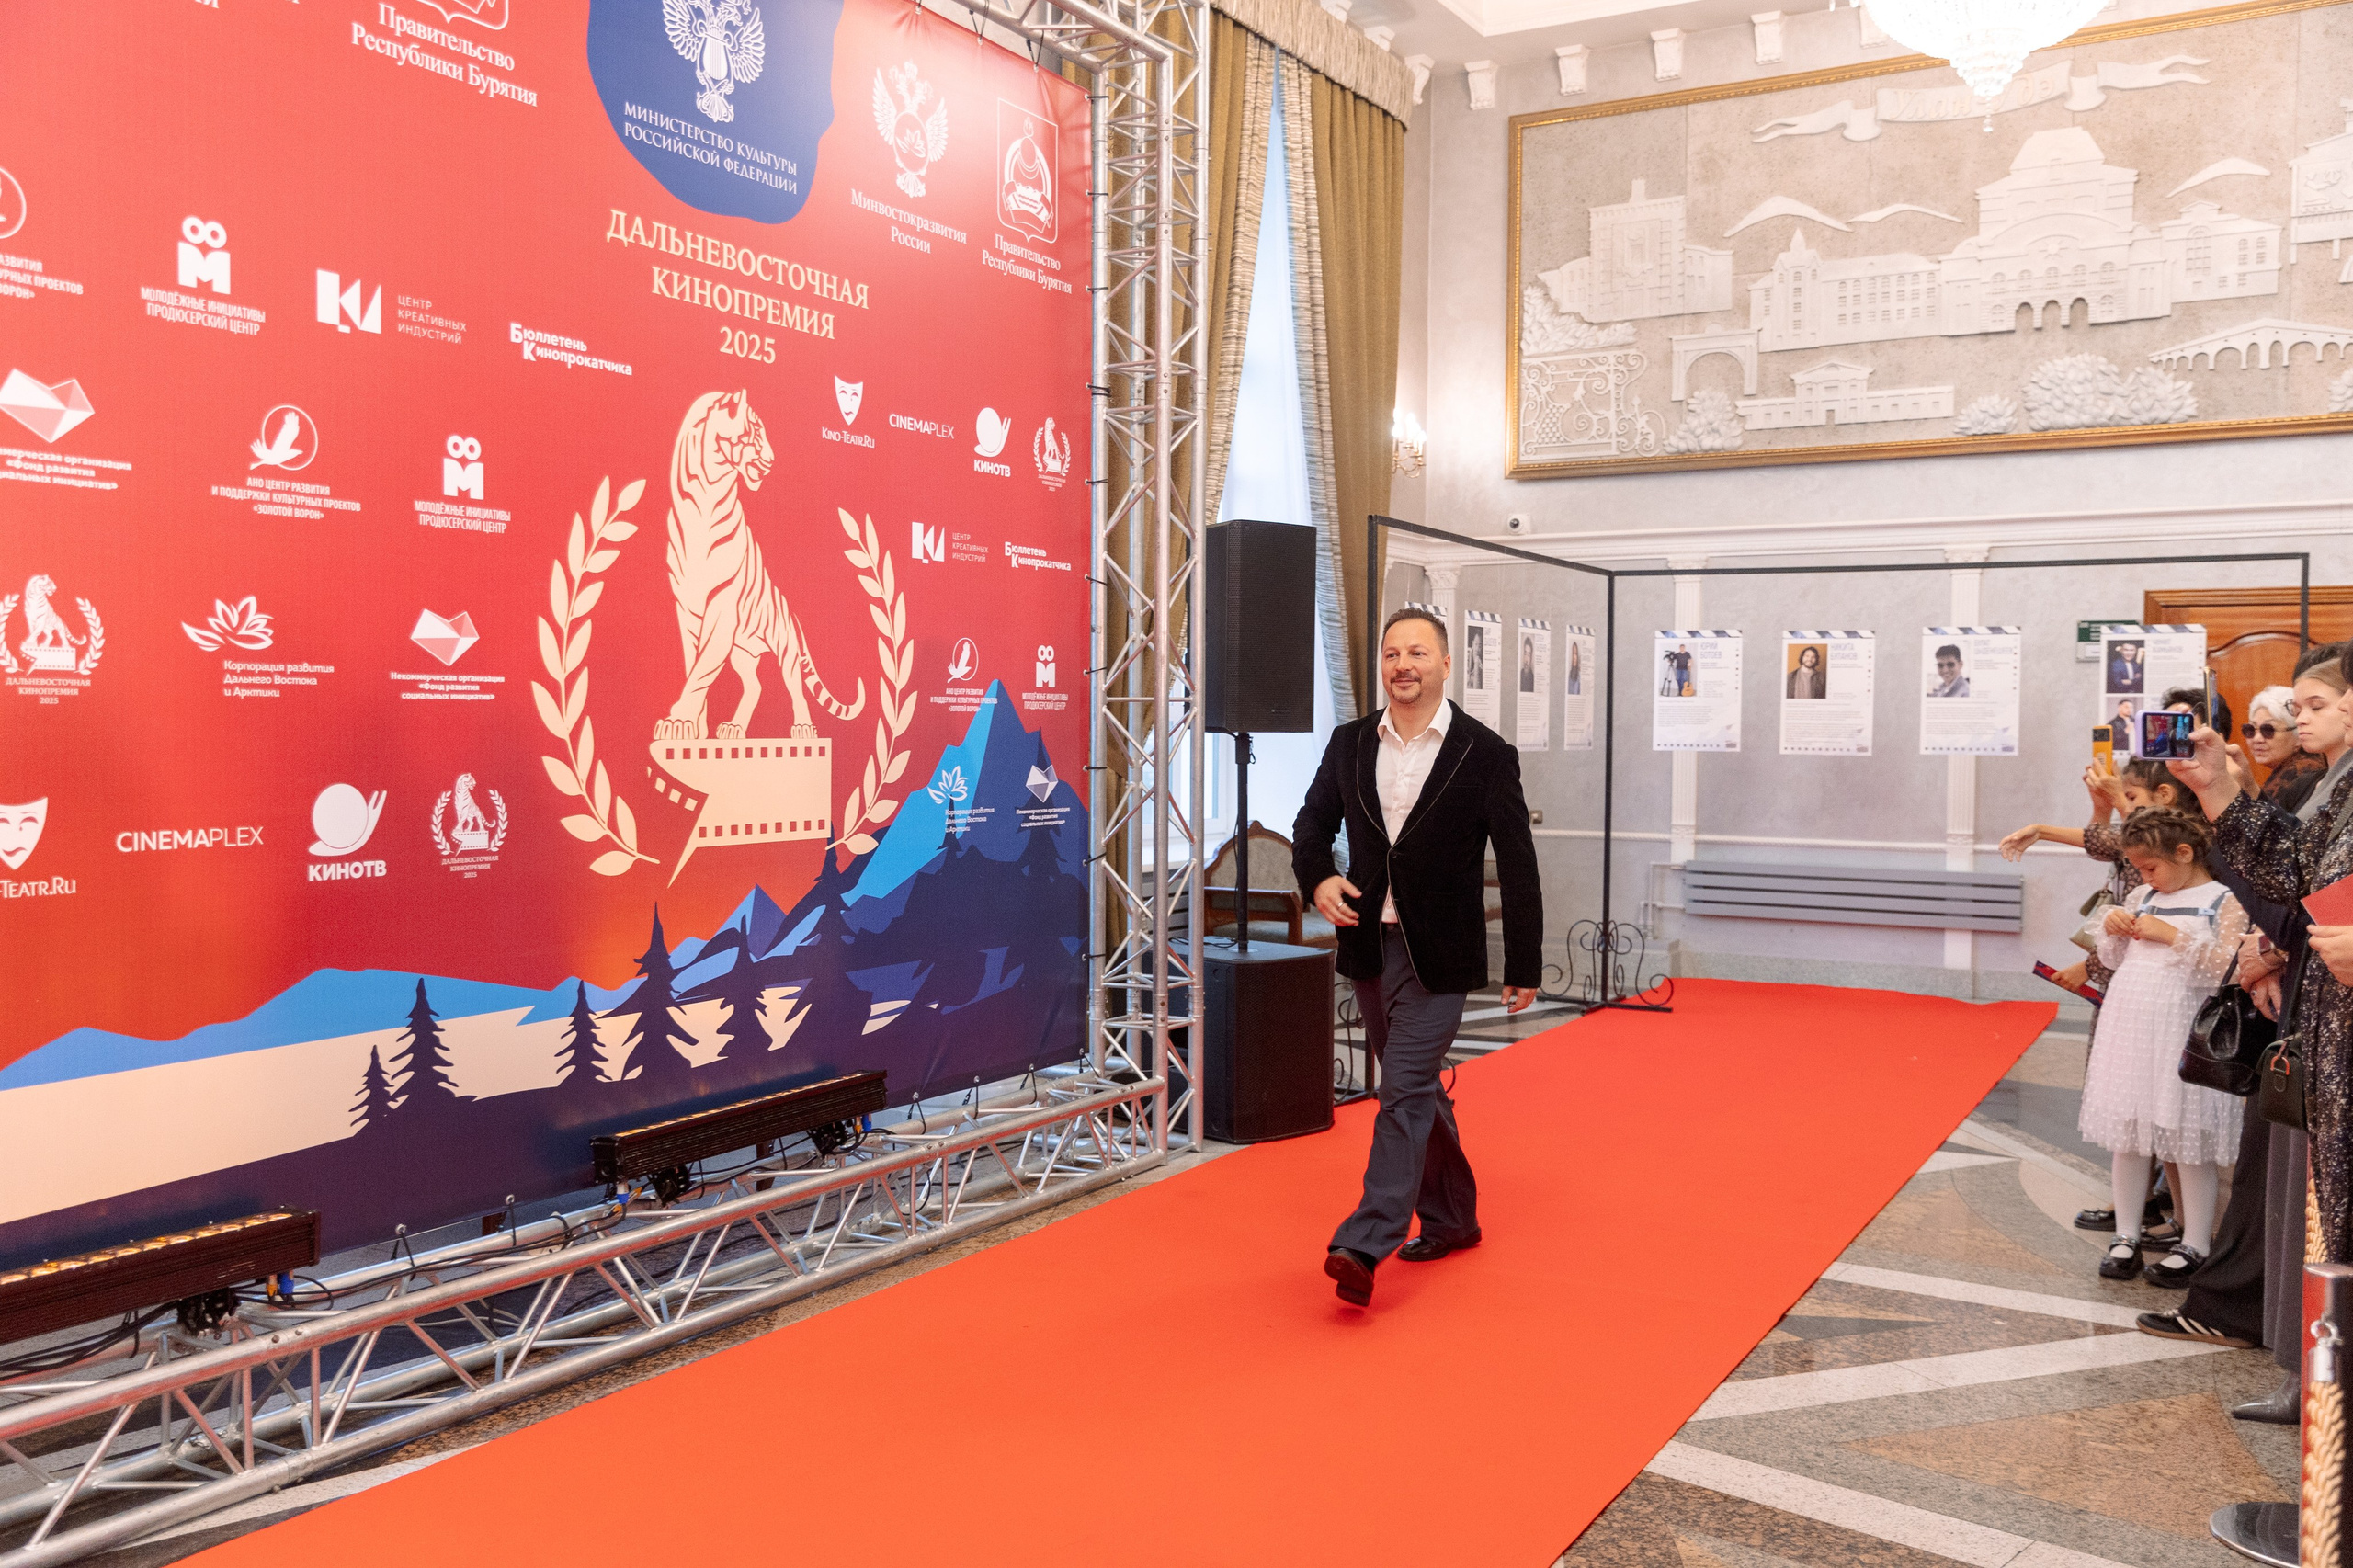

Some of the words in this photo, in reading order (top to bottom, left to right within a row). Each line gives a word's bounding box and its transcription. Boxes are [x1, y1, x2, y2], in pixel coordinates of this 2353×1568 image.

[378, 3, 515, 72] Правительство
[350, 22, 464, 83] Республики
[468, 68, 539, 107] Бурятия
[624, 102, 733, 152] МИНИСТЕРСТВО
[737, 142, 797, 176] КУЛЬТУРЫ
[624, 122, 720, 167] РОССИЙСКОЙ
[724, 157, 797, 195] ФЕДЕРАЦИИ
[851, 188, 967, 244] Минвостокразвития
[891, 226, 931, 254] России
[607, 210, 869, 309] ДАЛЬНЕВОСТОЧНАЯ
[995, 234, 1061, 271] Правительство
[983, 250, 1036, 282] Республики
[1038, 269, 1072, 294] Бурятия
[34, 275, 84, 295] ПРОЕКТОВ
[141, 286, 206, 311] МОЛОДЁЖНЫЕ
[208, 301, 266, 323] ИНИЦИАТИВЫ
[398, 295, 432, 311] ЦЕНТР
[652, 267, 835, 339] КИНОПРЕМИЯ
[146, 301, 228, 331] ПРОДЮСЕРСКИЙ
[230, 319, 260, 335] ЦЕНТР
[398, 310, 467, 332] КРЕАТИВНЫХ
[398, 324, 461, 345] ИНДУСТРИЙ
[510, 322, 588, 352] Бюллетень
[720, 327, 776, 364] 2025
[523, 341, 632, 376] Кинопрокатчика
[889, 414, 954, 439] CINEMAPLEX
[45, 464, 96, 477] развития
[64, 456, 131, 471] организация
[974, 460, 1011, 477] КИНОТВ
[246, 477, 264, 489] АНО
[265, 479, 290, 493] ЦЕНТР
[291, 482, 330, 495] РАЗВИТИЯ
[220, 487, 270, 502] ПОДДЕРЖКИ
[272, 493, 323, 506] КУЛЬТУРНЫХ
[324, 498, 361, 512] ПРОЕКТОВ
[419, 513, 482, 531] ПРОДЮСЕРСКИЙ
[483, 520, 506, 534] ЦЕНТР
[466, 506, 511, 521] ИНИЦИАТИВЫ
[952, 542, 988, 553] КРЕАТИВНЫХ
[952, 552, 986, 562] ИНДУСТРИЙ
[1005, 541, 1046, 557] Бюллетень
[1011, 554, 1071, 571] Кинопрокатчика
[224, 660, 284, 674] Корпорация
[287, 662, 335, 675] развития
[6, 677, 91, 687] ДАЛЬНЕВОСТОЧНАЯ
[224, 674, 272, 686] Дальнего
[274, 675, 318, 686] Востока
[391, 672, 457, 684] Некоммерческая
[458, 674, 505, 685] организация
[446, 683, 480, 693] развития
[18, 687, 79, 696] КИНОПРЕМИЯ
[40, 697, 59, 705] 2025
[224, 687, 232, 697] и
[233, 687, 280, 699] Арктики
[116, 826, 264, 853] CINEMAPLEX
[308, 860, 387, 882] КИНОТВ
